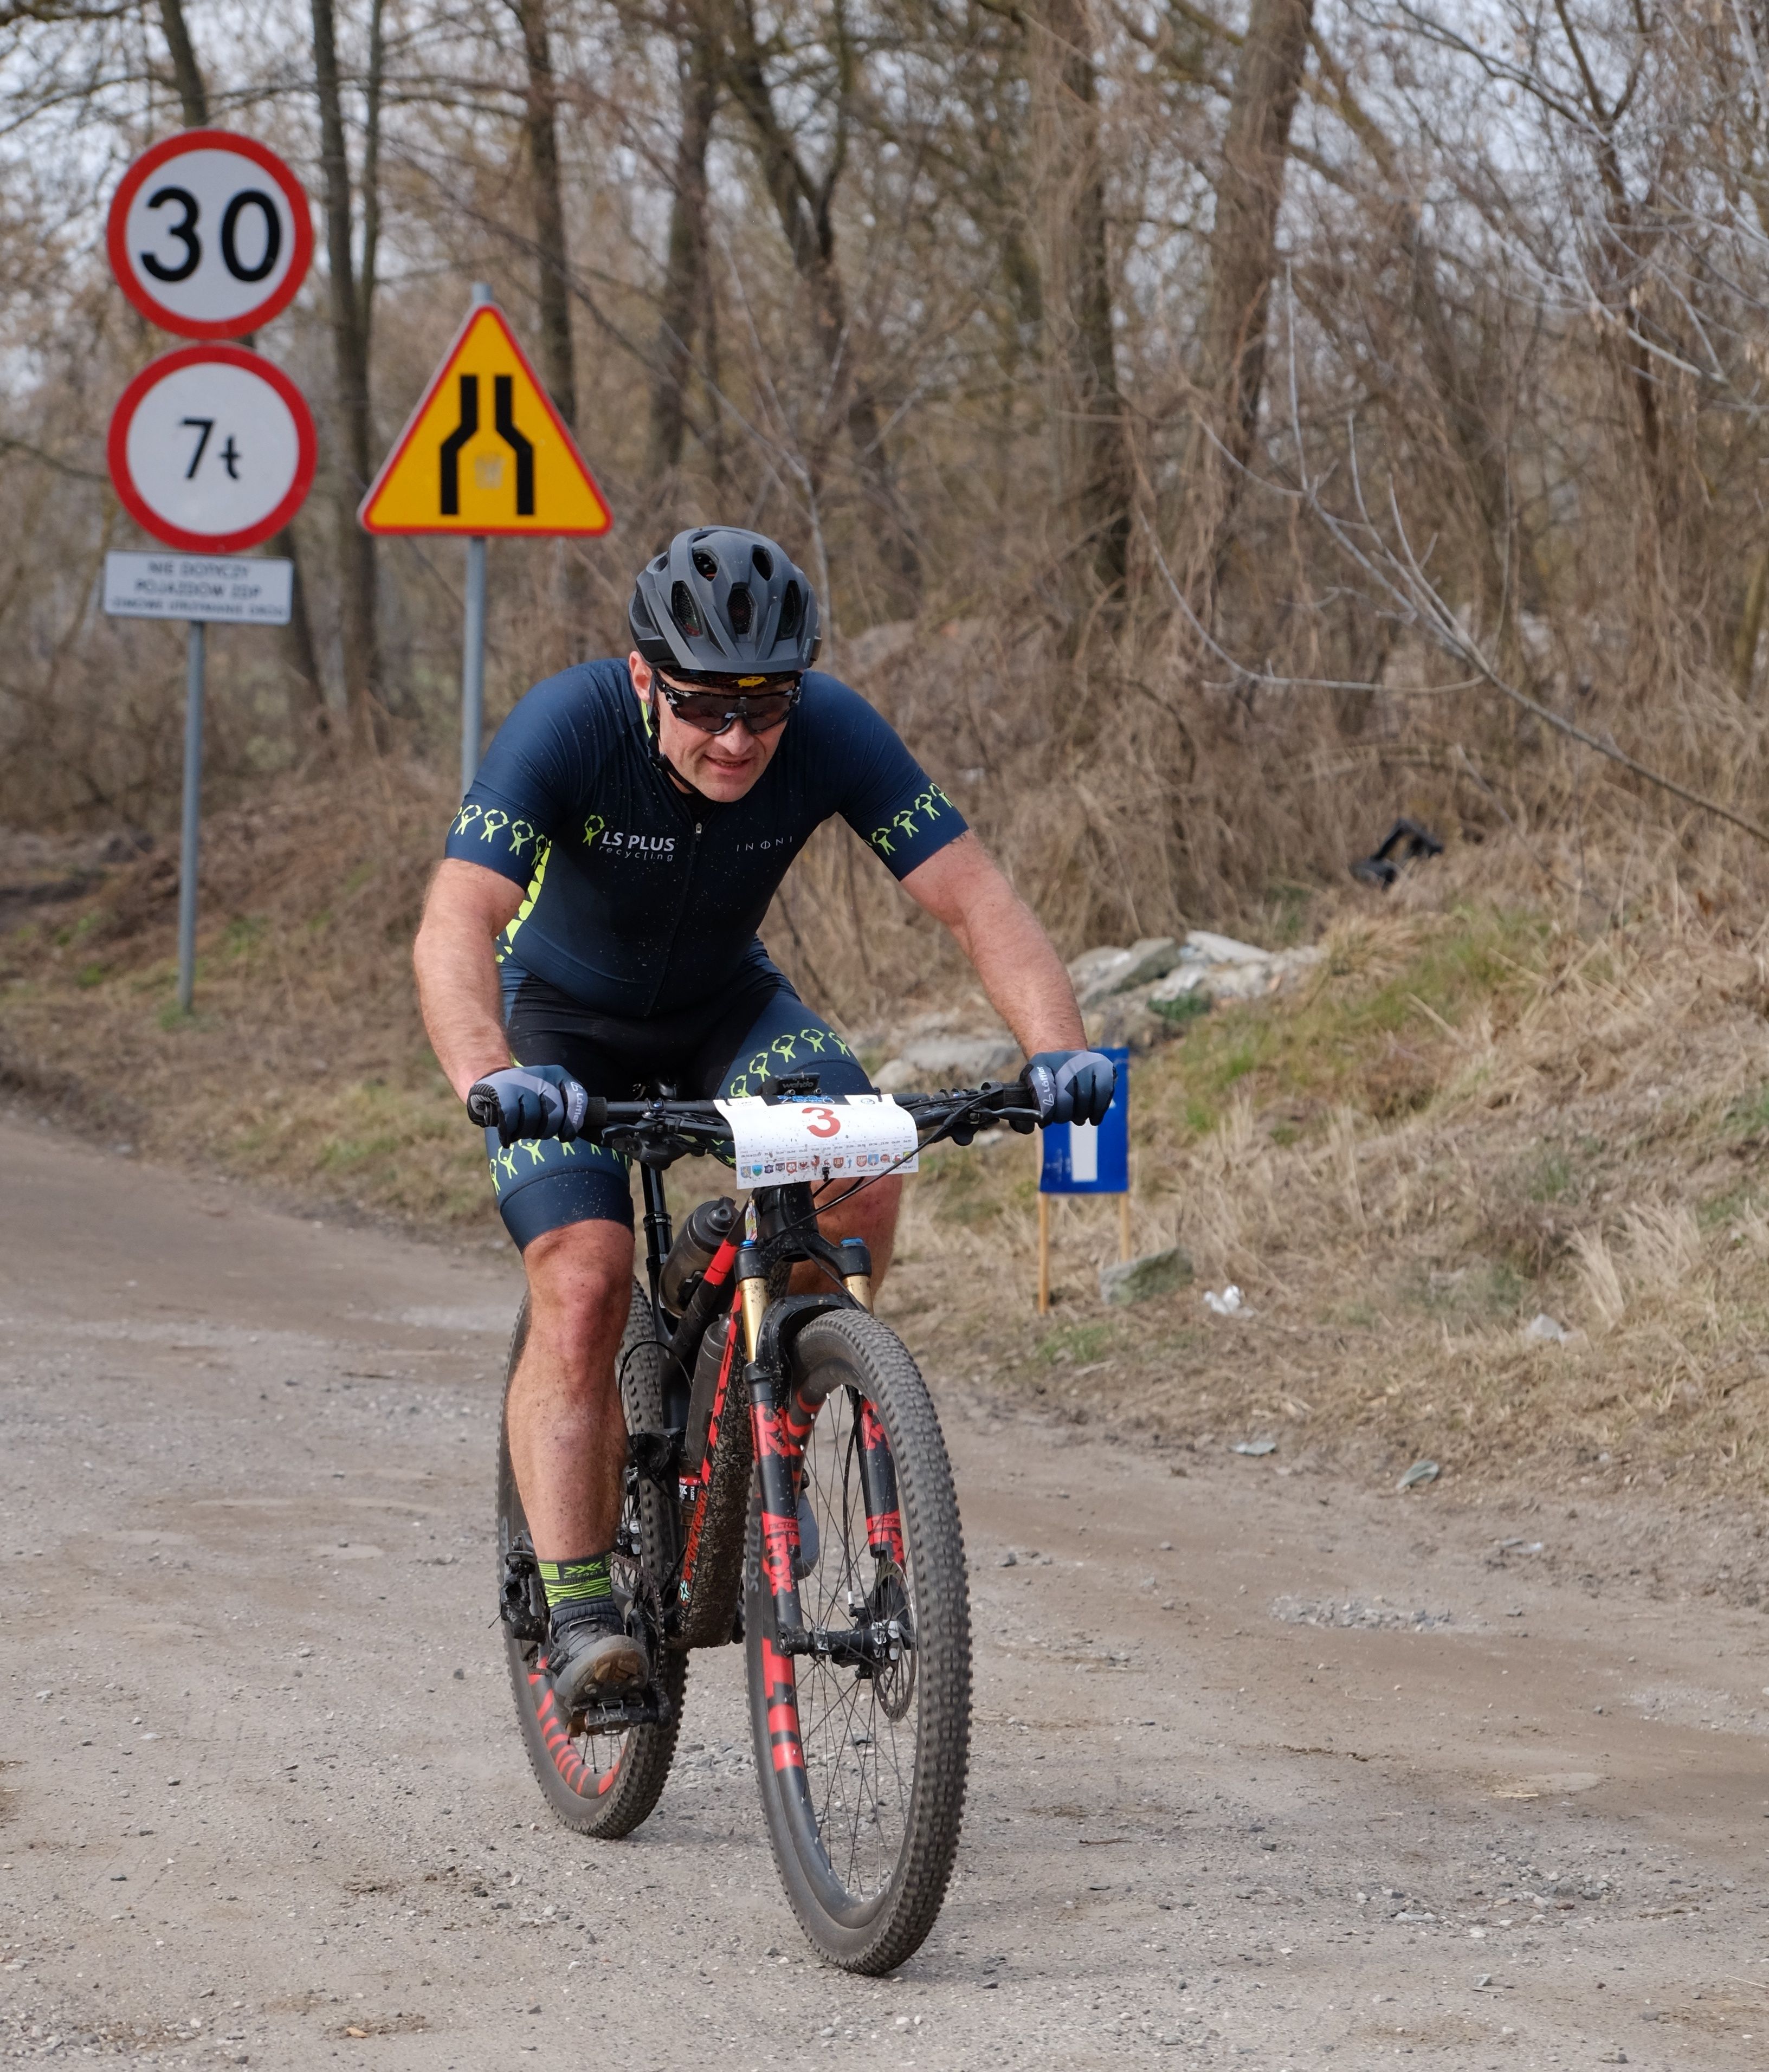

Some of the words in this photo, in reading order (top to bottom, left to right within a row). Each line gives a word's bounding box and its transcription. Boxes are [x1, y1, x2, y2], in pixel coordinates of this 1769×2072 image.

[140, 186, 281, 282] 30
[147, 561, 174, 574] NIE
[179, 562, 249, 578] DOTYCZY
[602, 831, 624, 846] LS
[628, 835, 675, 851] PLUS
[599, 845, 674, 862] recycling
[782, 1080, 814, 1089] wahoo
[802, 1106, 841, 1138] 3
[747, 1515, 761, 1591] SCYLLA
